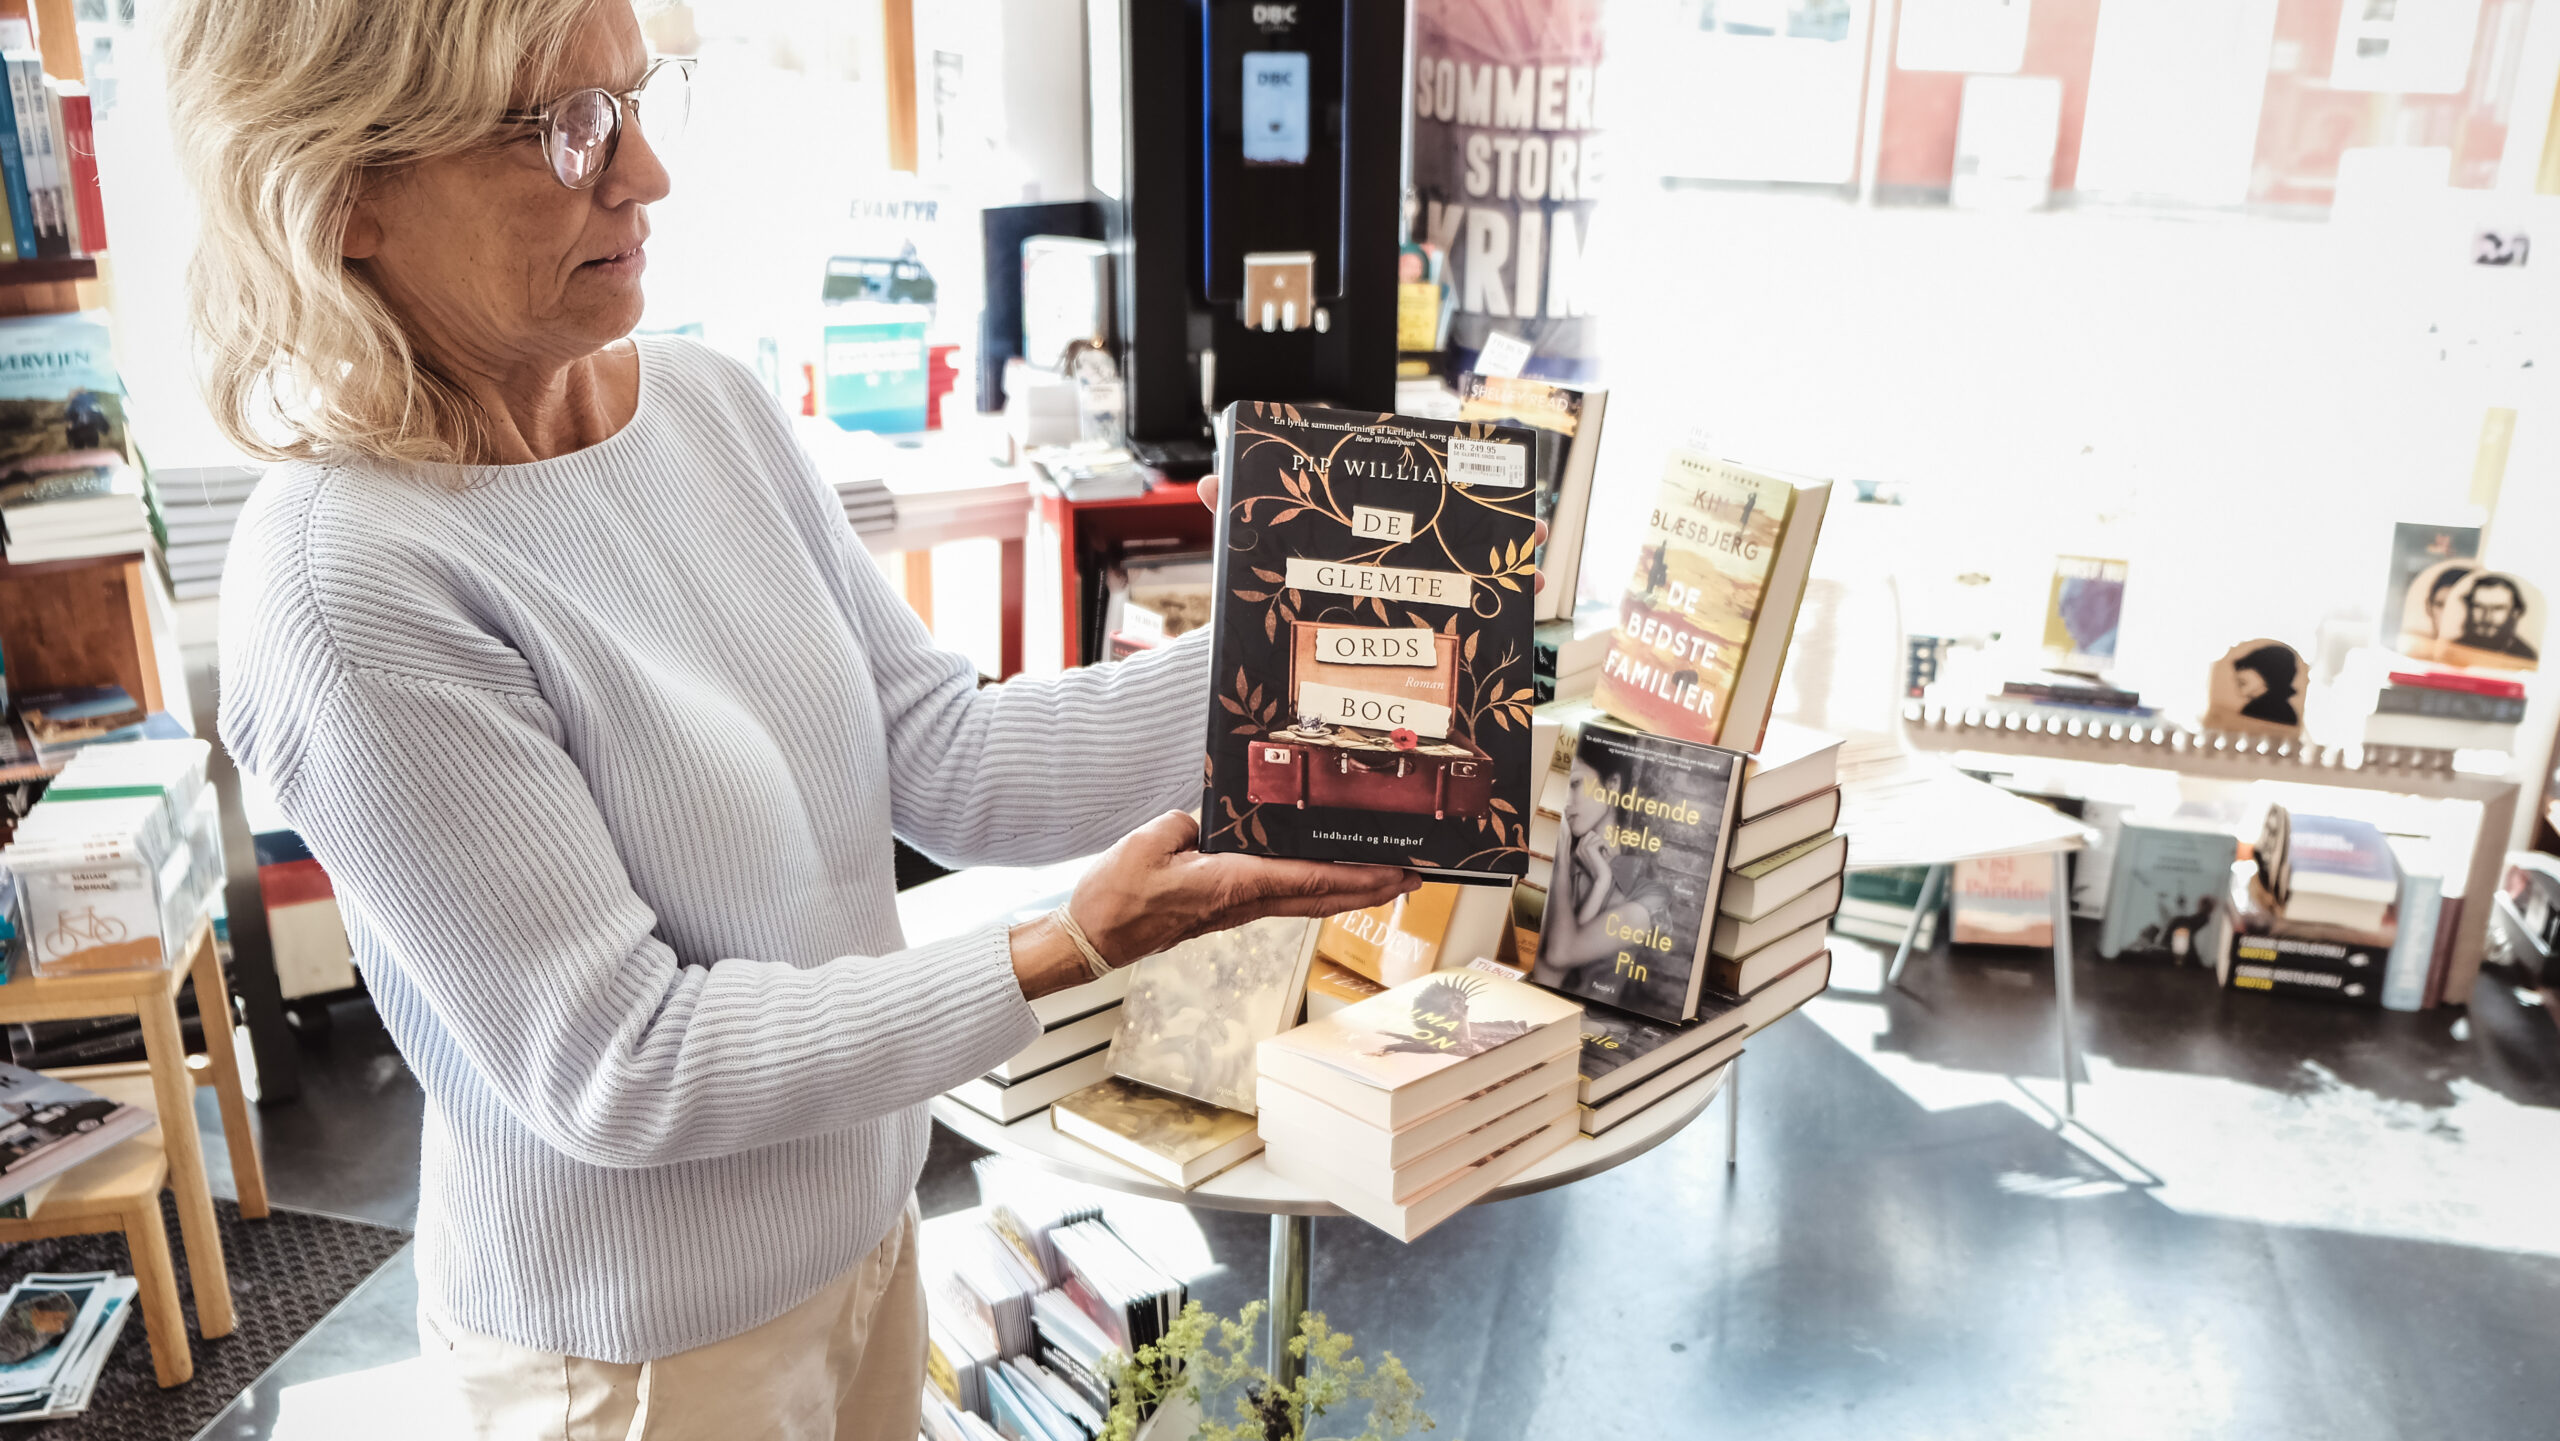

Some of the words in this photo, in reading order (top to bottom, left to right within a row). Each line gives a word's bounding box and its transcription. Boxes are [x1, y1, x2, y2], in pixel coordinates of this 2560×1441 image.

[1417, 57, 1598, 131] SOMMER
[1471, 383, 1526, 404] SHELLEY
[1530, 394, 1568, 411] READ
[1287, 418, 1309, 428] lyrisk
[1311, 421, 1375, 435] sammenfletning
[1376, 426, 1385, 435] af
[1429, 432, 1446, 442] sorg
[1355, 434, 1373, 443] Reese
[1292, 454, 1331, 474] PIP
[1344, 459, 1475, 487] WILLIA
[1363, 513, 1401, 536] DE
[1650, 507, 1760, 562] BLÆSBJERG
[1316, 566, 1443, 598] GLEMTE
[1666, 579, 1702, 615] DE
[1335, 637, 1419, 658] ORDS
[1625, 610, 1721, 671] BEDSTE
[1405, 676, 1445, 690] Roman
[1603, 648, 1716, 720] FAMILIER
[1341, 697, 1406, 725] BOG
[1584, 775, 1700, 825] Vandrende
[1312, 830, 1363, 842] Lindhardt
[1366, 836, 1379, 845] og
[1383, 835, 1424, 847] Ringhof
[1604, 825, 1661, 853] sjæle
[1605, 913, 1672, 952] Cecile
[1475, 959, 1517, 979] TILBUD
[1615, 951, 1647, 983] Pin
[1580, 1031, 1620, 1050] cile
